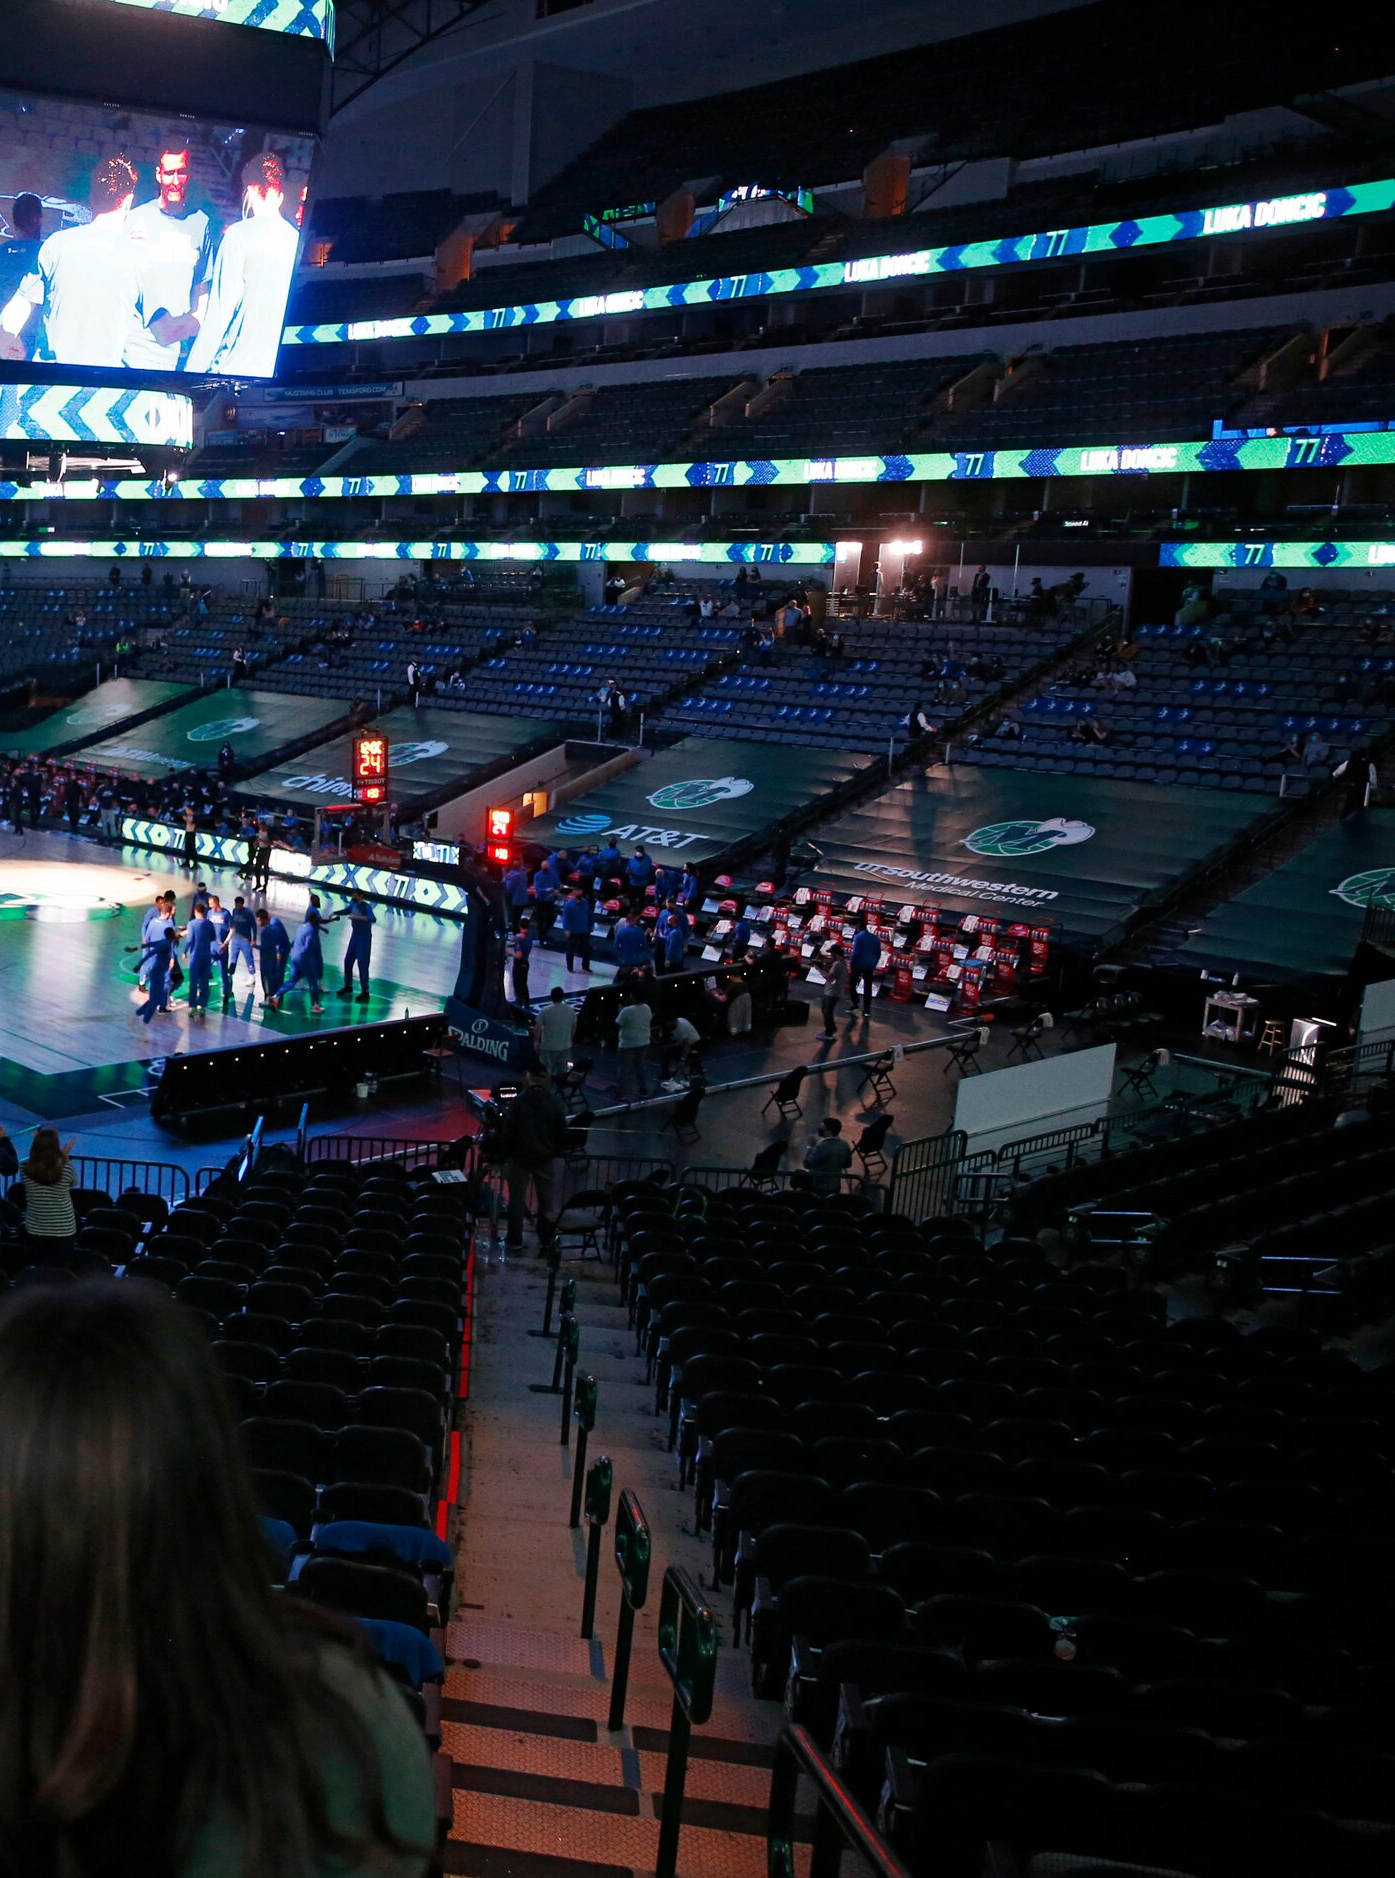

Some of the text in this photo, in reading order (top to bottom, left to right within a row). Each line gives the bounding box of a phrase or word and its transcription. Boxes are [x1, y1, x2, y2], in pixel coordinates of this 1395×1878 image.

[1203, 192, 1326, 235] LUKA DONCIC
[1046, 231, 1069, 257] 77
[844, 258, 878, 282] LUKA
[730, 275, 747, 298] 77
[492, 308, 506, 328] 77
[316, 388, 334, 396] CLUB
[1081, 449, 1118, 471] LUKA
[1294, 438, 1321, 464] 77
[714, 463, 729, 483] 77
[965, 453, 984, 476] 77
[348, 478, 361, 494] 77
[514, 471, 528, 489] 77
[585, 543, 597, 559] 77
[760, 544, 774, 560] 77
[1244, 544, 1265, 564] 77
[359, 755, 380, 775] 24
[600, 824, 710, 848] AT&T
[436, 845, 450, 863] 77
[394, 874, 410, 898] 77
[904, 881, 1046, 907] Medical Center
